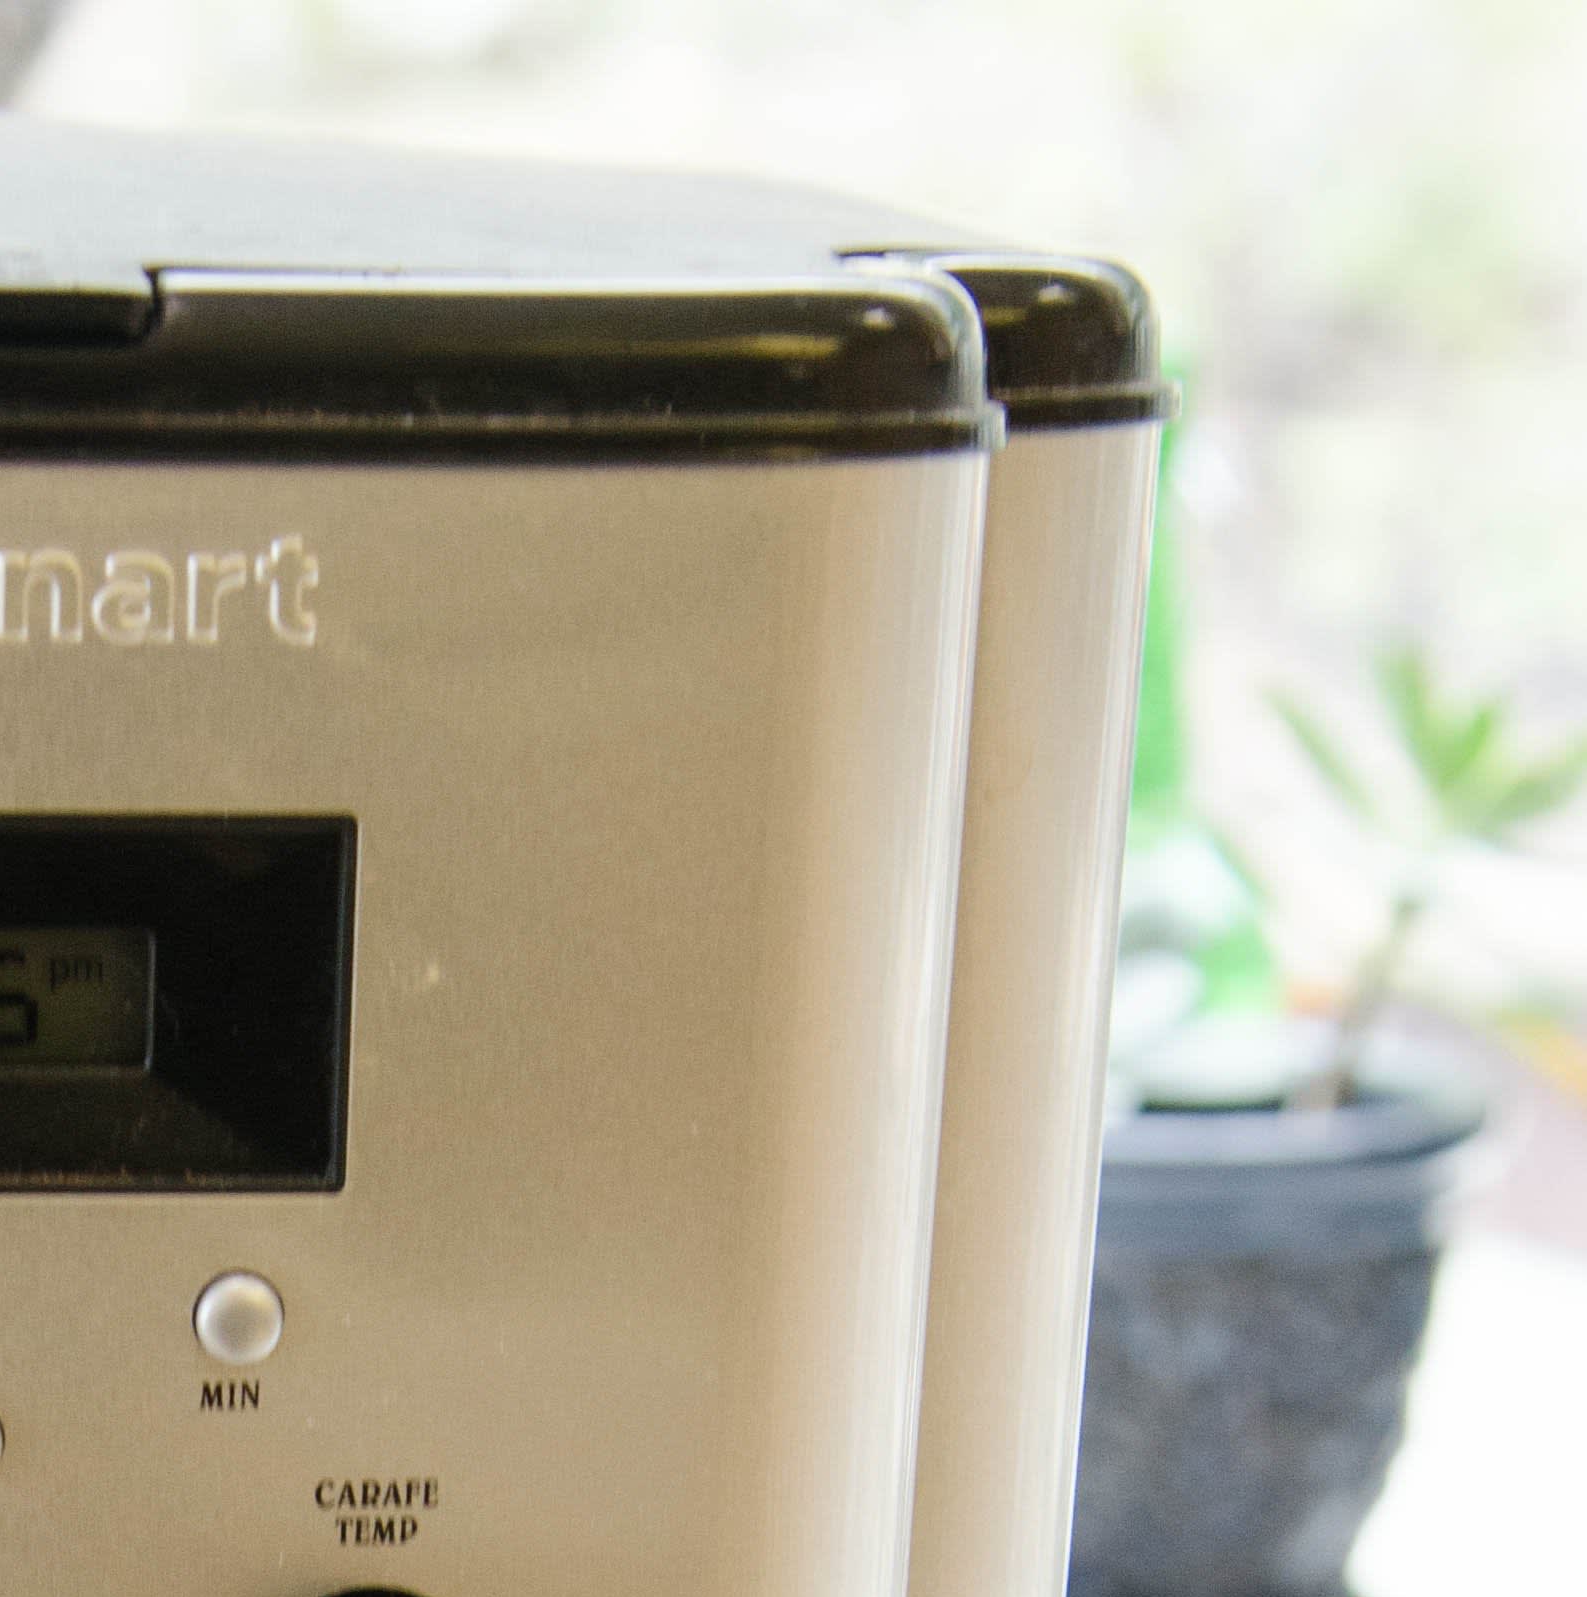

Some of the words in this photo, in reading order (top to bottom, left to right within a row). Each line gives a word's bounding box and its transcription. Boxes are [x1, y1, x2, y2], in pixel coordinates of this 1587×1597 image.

[48, 955, 103, 993] pm
[200, 1380, 261, 1411] MIN
[315, 1479, 439, 1510] CARAFE
[335, 1517, 418, 1546] TEMP
